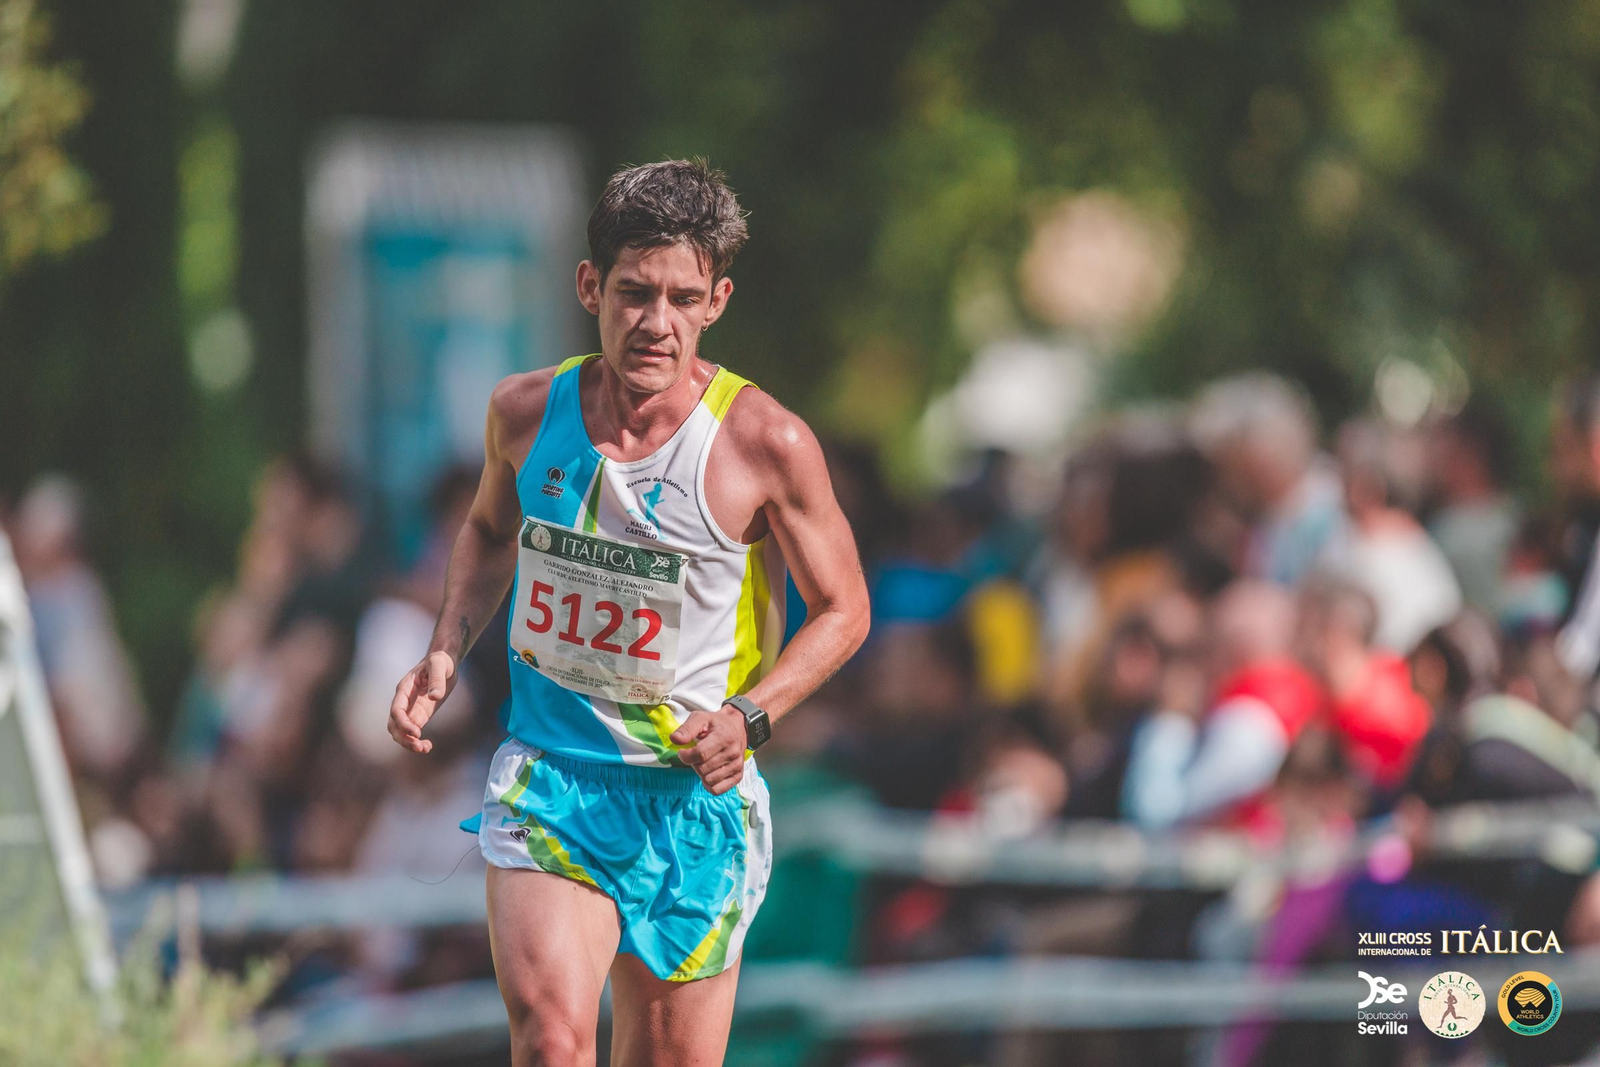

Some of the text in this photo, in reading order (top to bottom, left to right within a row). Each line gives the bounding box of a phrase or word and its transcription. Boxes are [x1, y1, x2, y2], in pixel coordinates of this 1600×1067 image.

[543, 483, 564, 493] SPORTING
[626, 477, 651, 489] Escuela
[661, 478, 688, 498] Atletismo
[625, 528, 657, 541] CASTILLO
[630, 520, 652, 531] MAURI
[561, 536, 636, 570] ITÁLICA
[544, 559, 654, 592] GARRIDO GONZALEZ, ALEJANDRO
[568, 575, 598, 587] ATLETISMO
[599, 581, 618, 592] MAURI
[618, 587, 648, 598] CASTILLO
[526, 580, 663, 662] 5122
